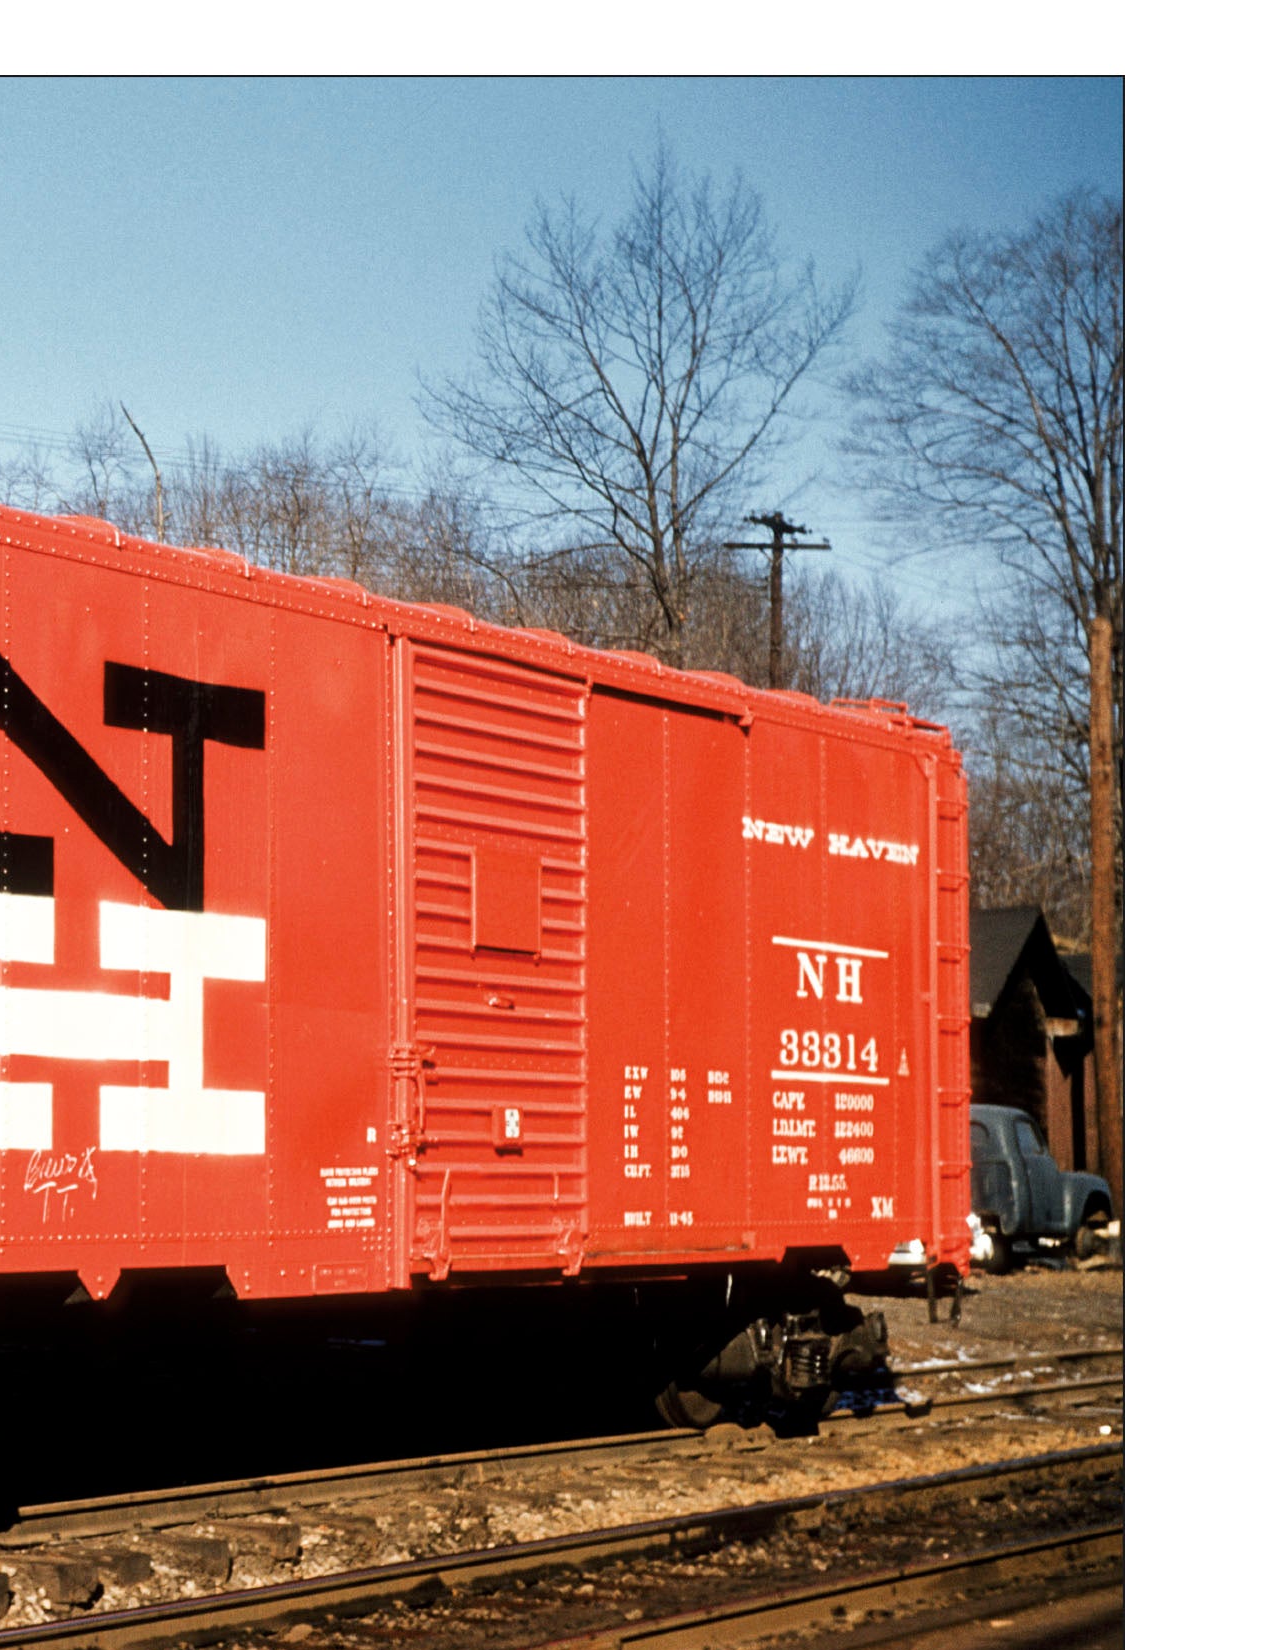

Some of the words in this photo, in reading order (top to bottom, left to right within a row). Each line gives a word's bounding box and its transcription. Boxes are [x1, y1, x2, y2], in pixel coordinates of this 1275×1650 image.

[742, 815, 815, 849] NEW
[828, 832, 920, 866] HAVEN
[779, 1029, 879, 1073] 33314
[871, 1196, 893, 1219] XM
